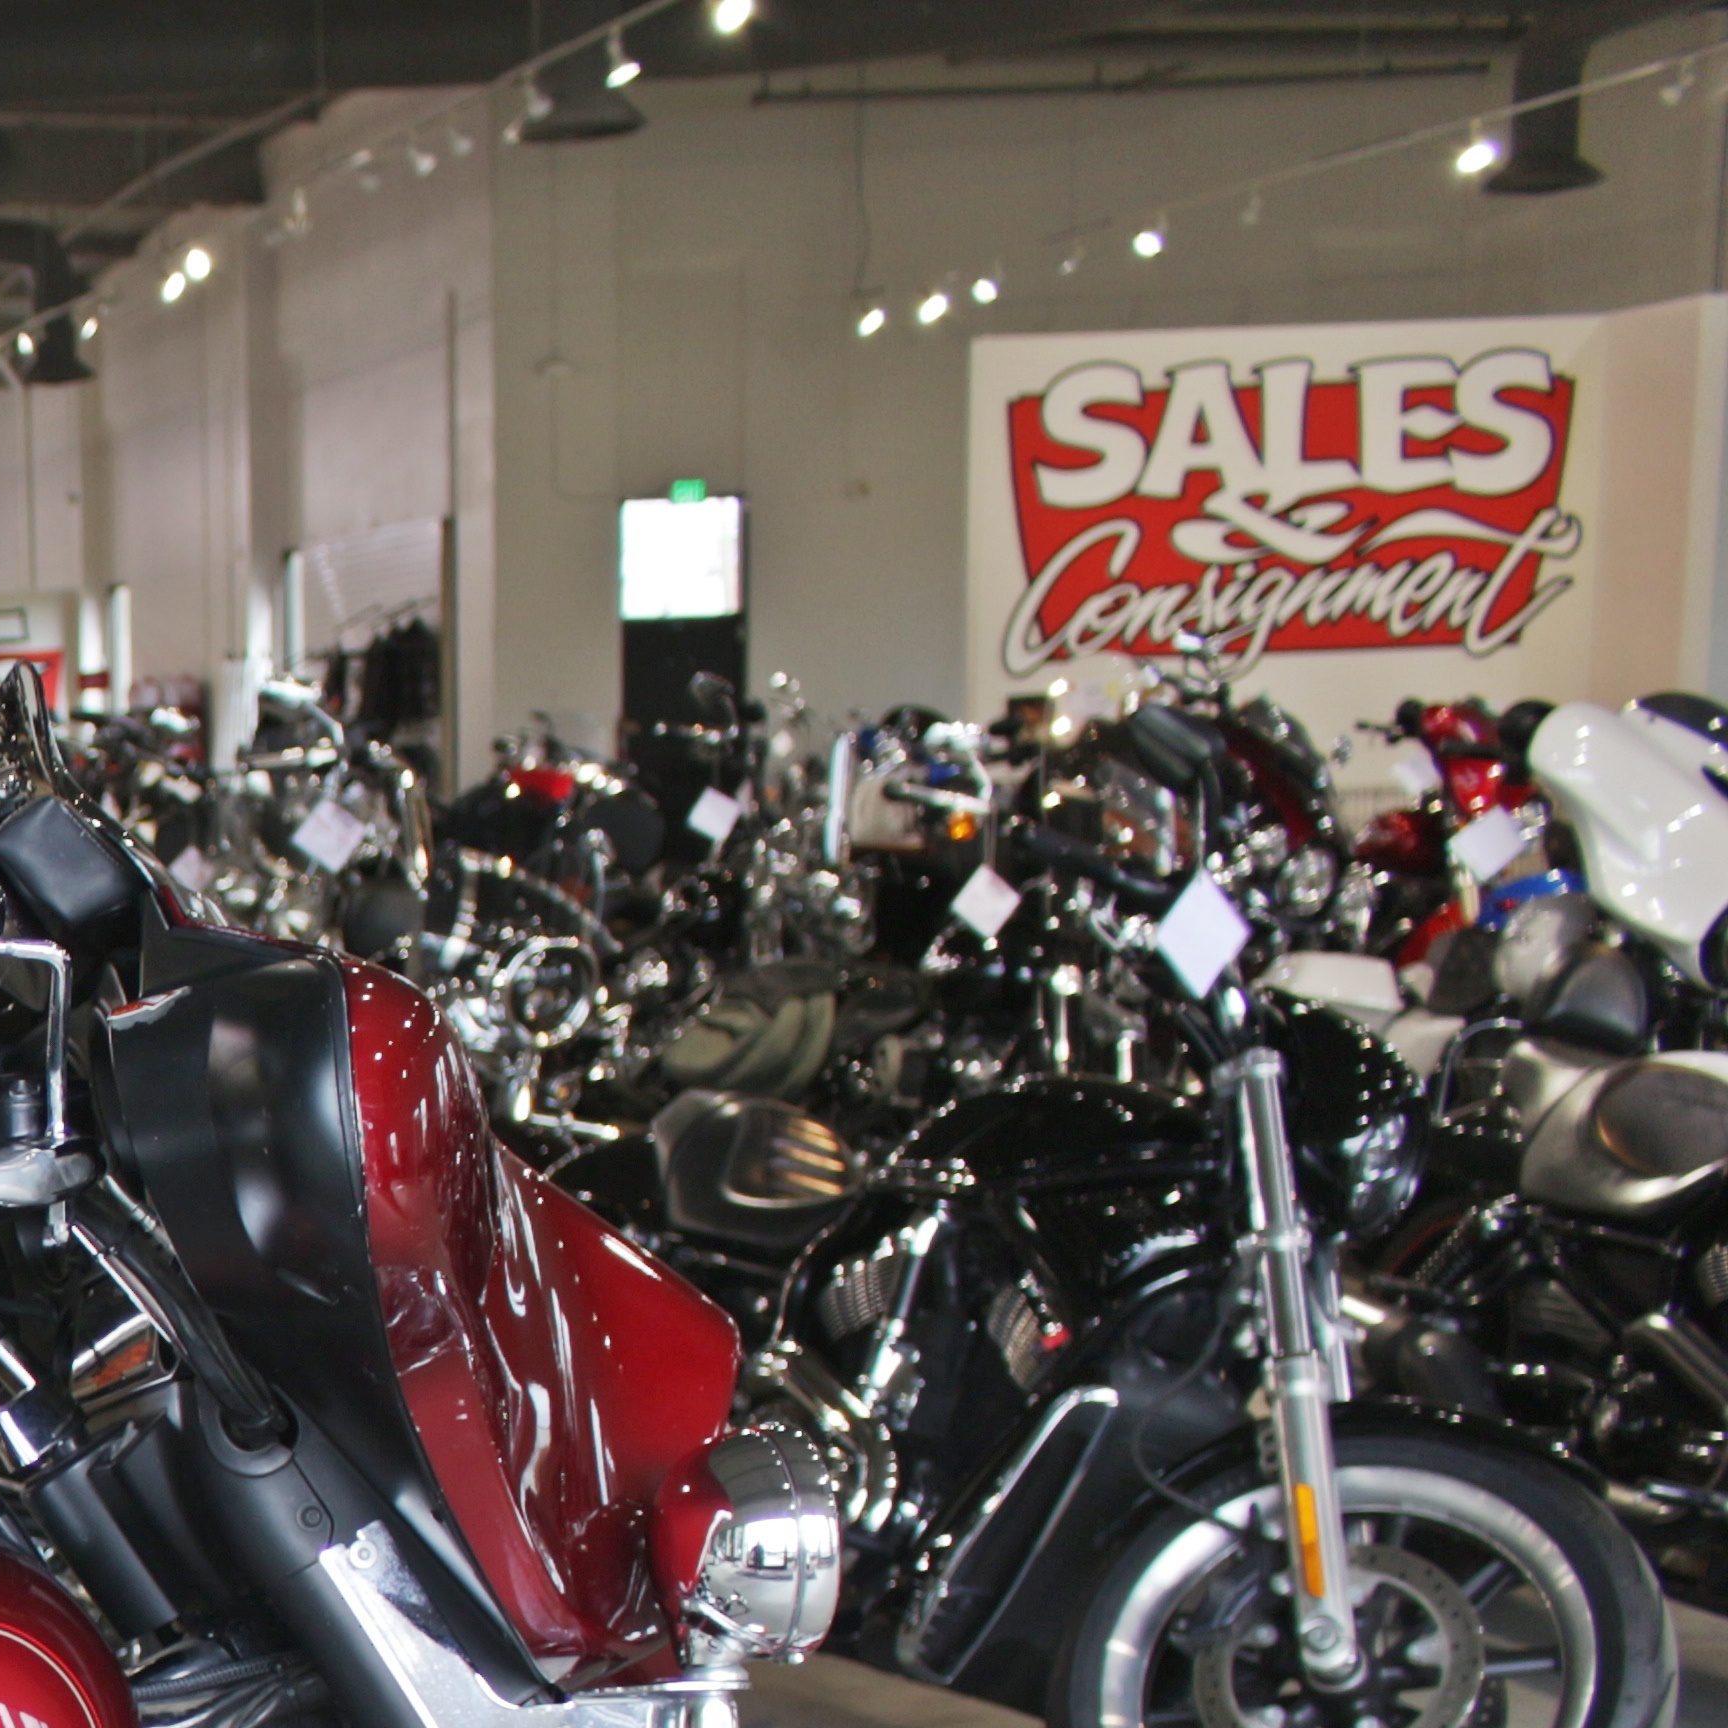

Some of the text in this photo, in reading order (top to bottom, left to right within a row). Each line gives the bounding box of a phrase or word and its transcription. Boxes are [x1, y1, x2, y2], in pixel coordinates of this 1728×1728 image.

[1032, 348, 1557, 509] SALES
[1002, 507, 1582, 679] Consignment
[1171, 486, 1376, 564] &
